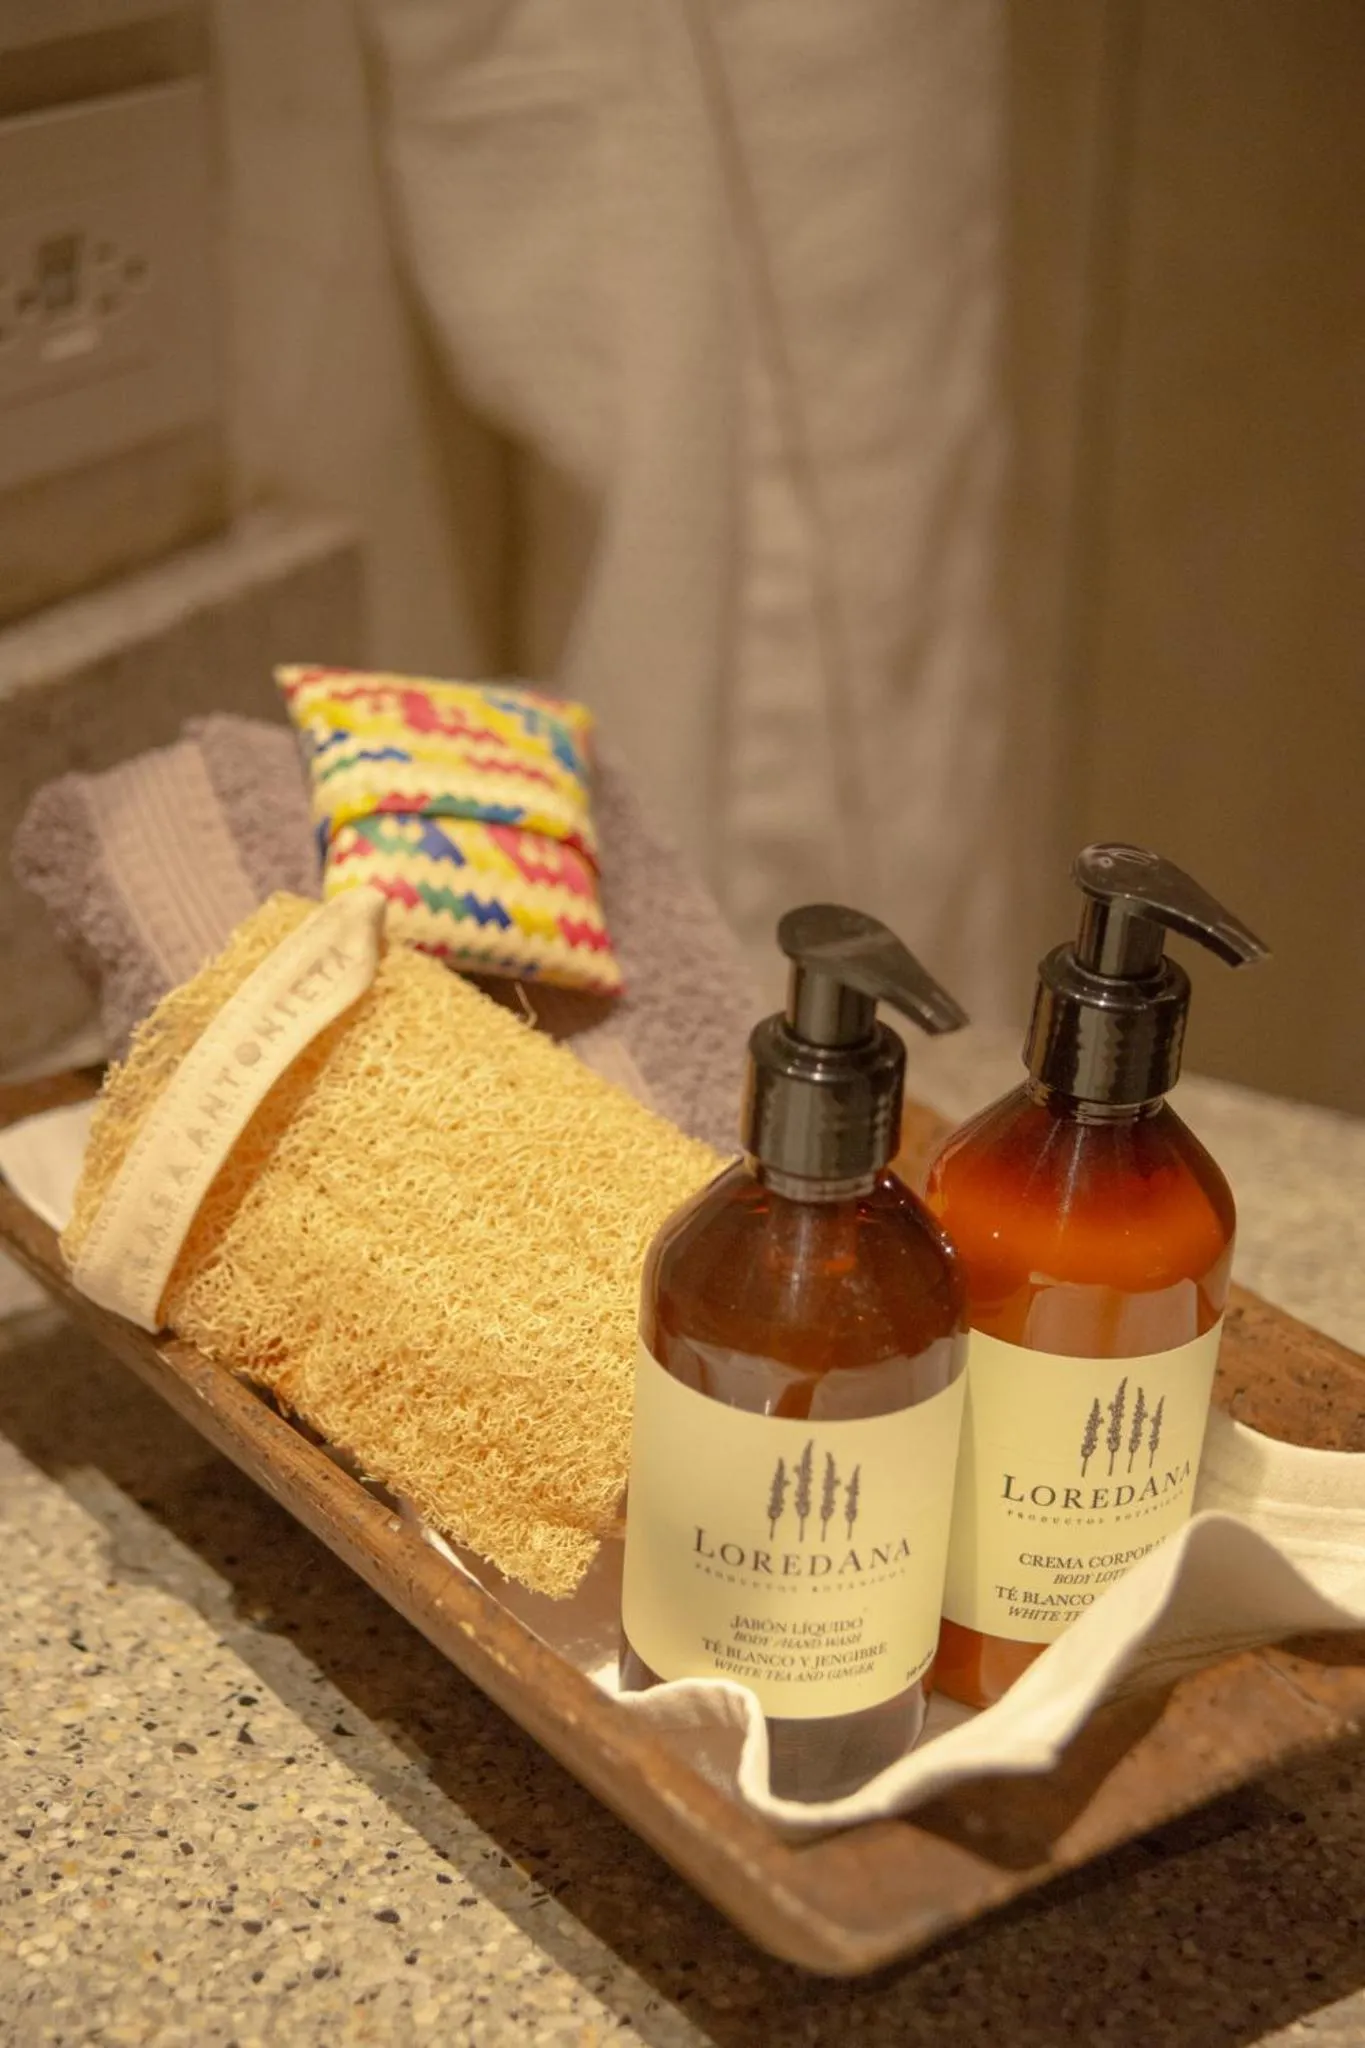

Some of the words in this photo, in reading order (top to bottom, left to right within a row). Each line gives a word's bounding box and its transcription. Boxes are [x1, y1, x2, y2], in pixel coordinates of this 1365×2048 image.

[1001, 1459, 1191, 1509] LOREDANA
[694, 1525, 911, 1577] LOREDANA
[1019, 1552, 1084, 1569] CREMA
[1053, 1573, 1092, 1586] BODY
[995, 1586, 1018, 1601] TÉ
[1023, 1591, 1095, 1607] BLANCO
[1008, 1606, 1061, 1622] WHITE
[725, 1645, 795, 1668] BLANCO
[799, 1655, 810, 1668] Y
[811, 1641, 889, 1670] JENGIBRE
[714, 1657, 763, 1679] WHITE
[765, 1668, 792, 1683] TEA
[794, 1670, 825, 1683] AND
